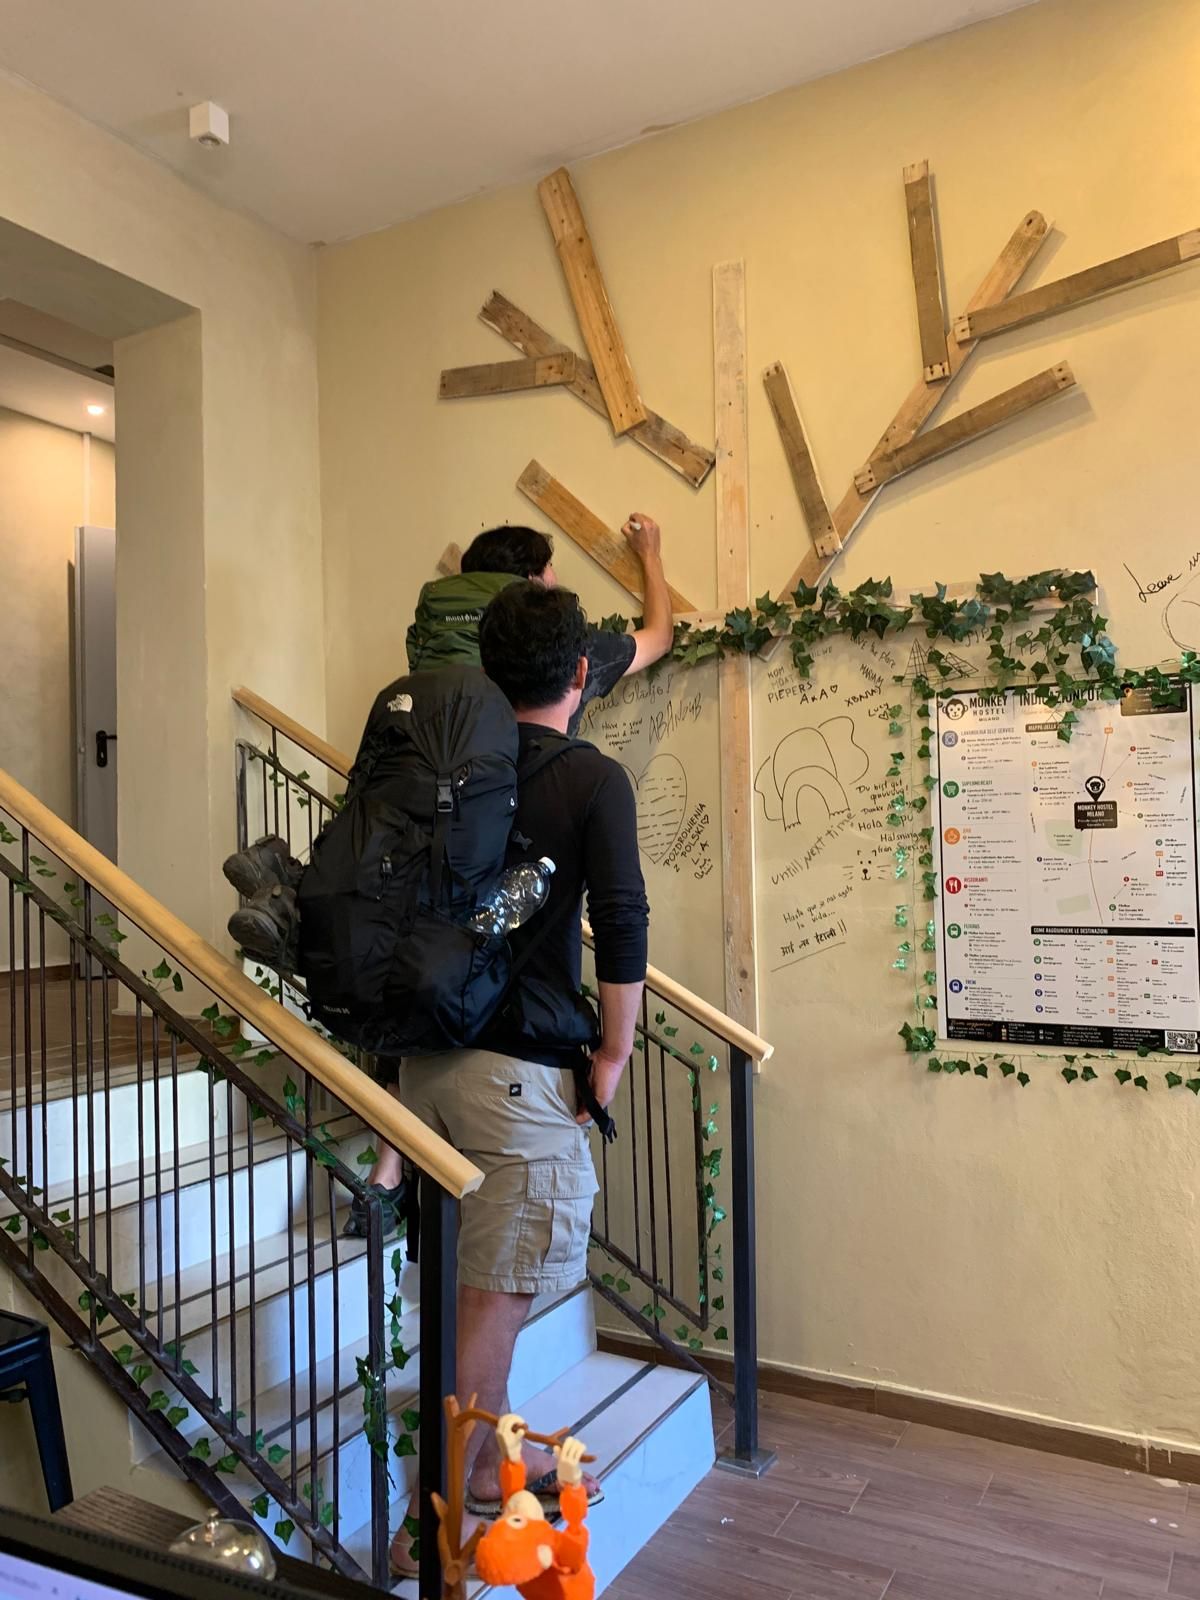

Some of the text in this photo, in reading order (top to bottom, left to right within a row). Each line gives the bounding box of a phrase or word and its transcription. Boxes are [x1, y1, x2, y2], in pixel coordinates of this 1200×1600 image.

[768, 681, 812, 703] PIEPERS
[969, 696, 1007, 708] MONKEY
[973, 708, 1005, 716] HOSTEL
[858, 819, 883, 831] Hola
[663, 803, 706, 867] POZDROWIENIA
[680, 824, 705, 858] POLSKI
